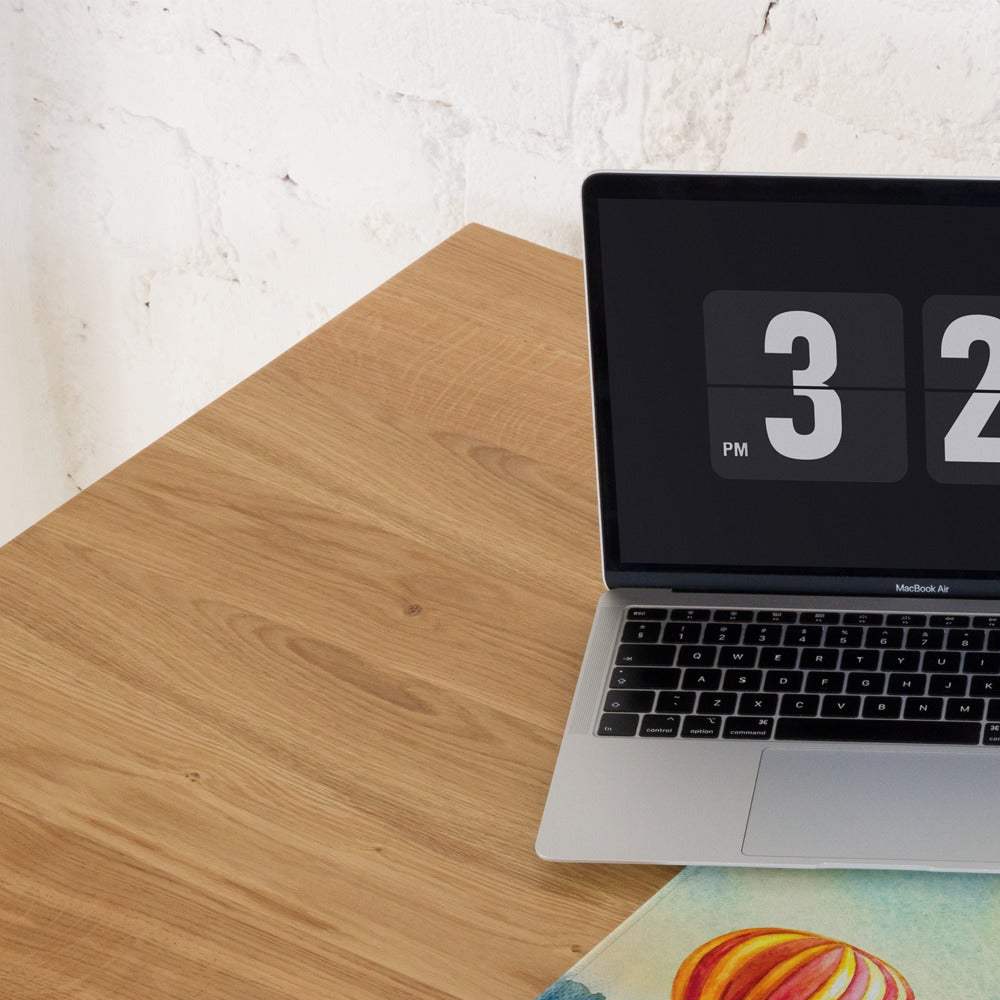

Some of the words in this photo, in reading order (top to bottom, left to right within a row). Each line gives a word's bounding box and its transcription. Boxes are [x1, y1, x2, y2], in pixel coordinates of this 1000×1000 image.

[765, 311, 842, 461] 3
[723, 441, 749, 457] PM
[895, 584, 937, 593] MacBook
[937, 584, 950, 593] Air
[718, 633, 726, 641] 2
[758, 634, 766, 642] 3
[798, 635, 806, 643] 4
[921, 638, 928, 646] 7
[961, 639, 969, 647] 8
[692, 651, 702, 660] Q
[732, 653, 744, 661] W
[774, 654, 782, 662] E
[856, 656, 864, 664] T
[897, 657, 905, 665] Y
[937, 658, 946, 666] U
[697, 675, 706, 683] A
[738, 676, 747, 684] S
[779, 677, 788, 685] D
[821, 678, 829, 686] F
[861, 679, 870, 687] G
[902, 680, 912, 688] H
[945, 681, 952, 689] J
[984, 682, 993, 690] K
[713, 699, 721, 707] Z
[754, 700, 763, 708] X
[795, 701, 805, 709] C
[837, 702, 846, 710] V
[877, 703, 886, 711] B
[919, 704, 928, 712] N
[959, 705, 970, 713] M
